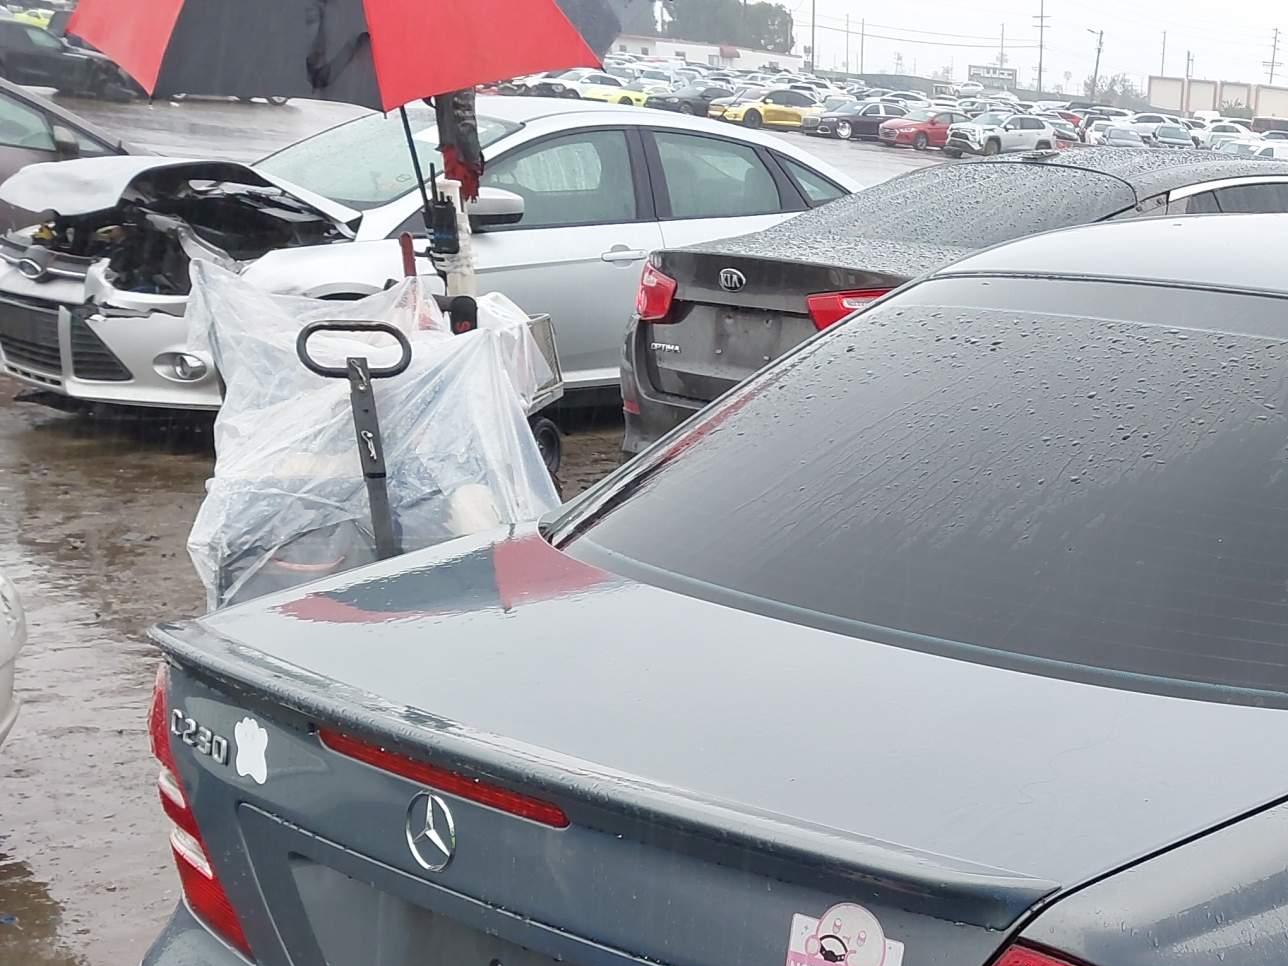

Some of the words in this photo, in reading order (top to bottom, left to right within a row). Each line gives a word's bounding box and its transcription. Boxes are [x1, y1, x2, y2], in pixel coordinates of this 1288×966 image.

[720, 273, 741, 288] KIA
[651, 342, 680, 353] OPTIMA
[171, 708, 228, 764] C230
